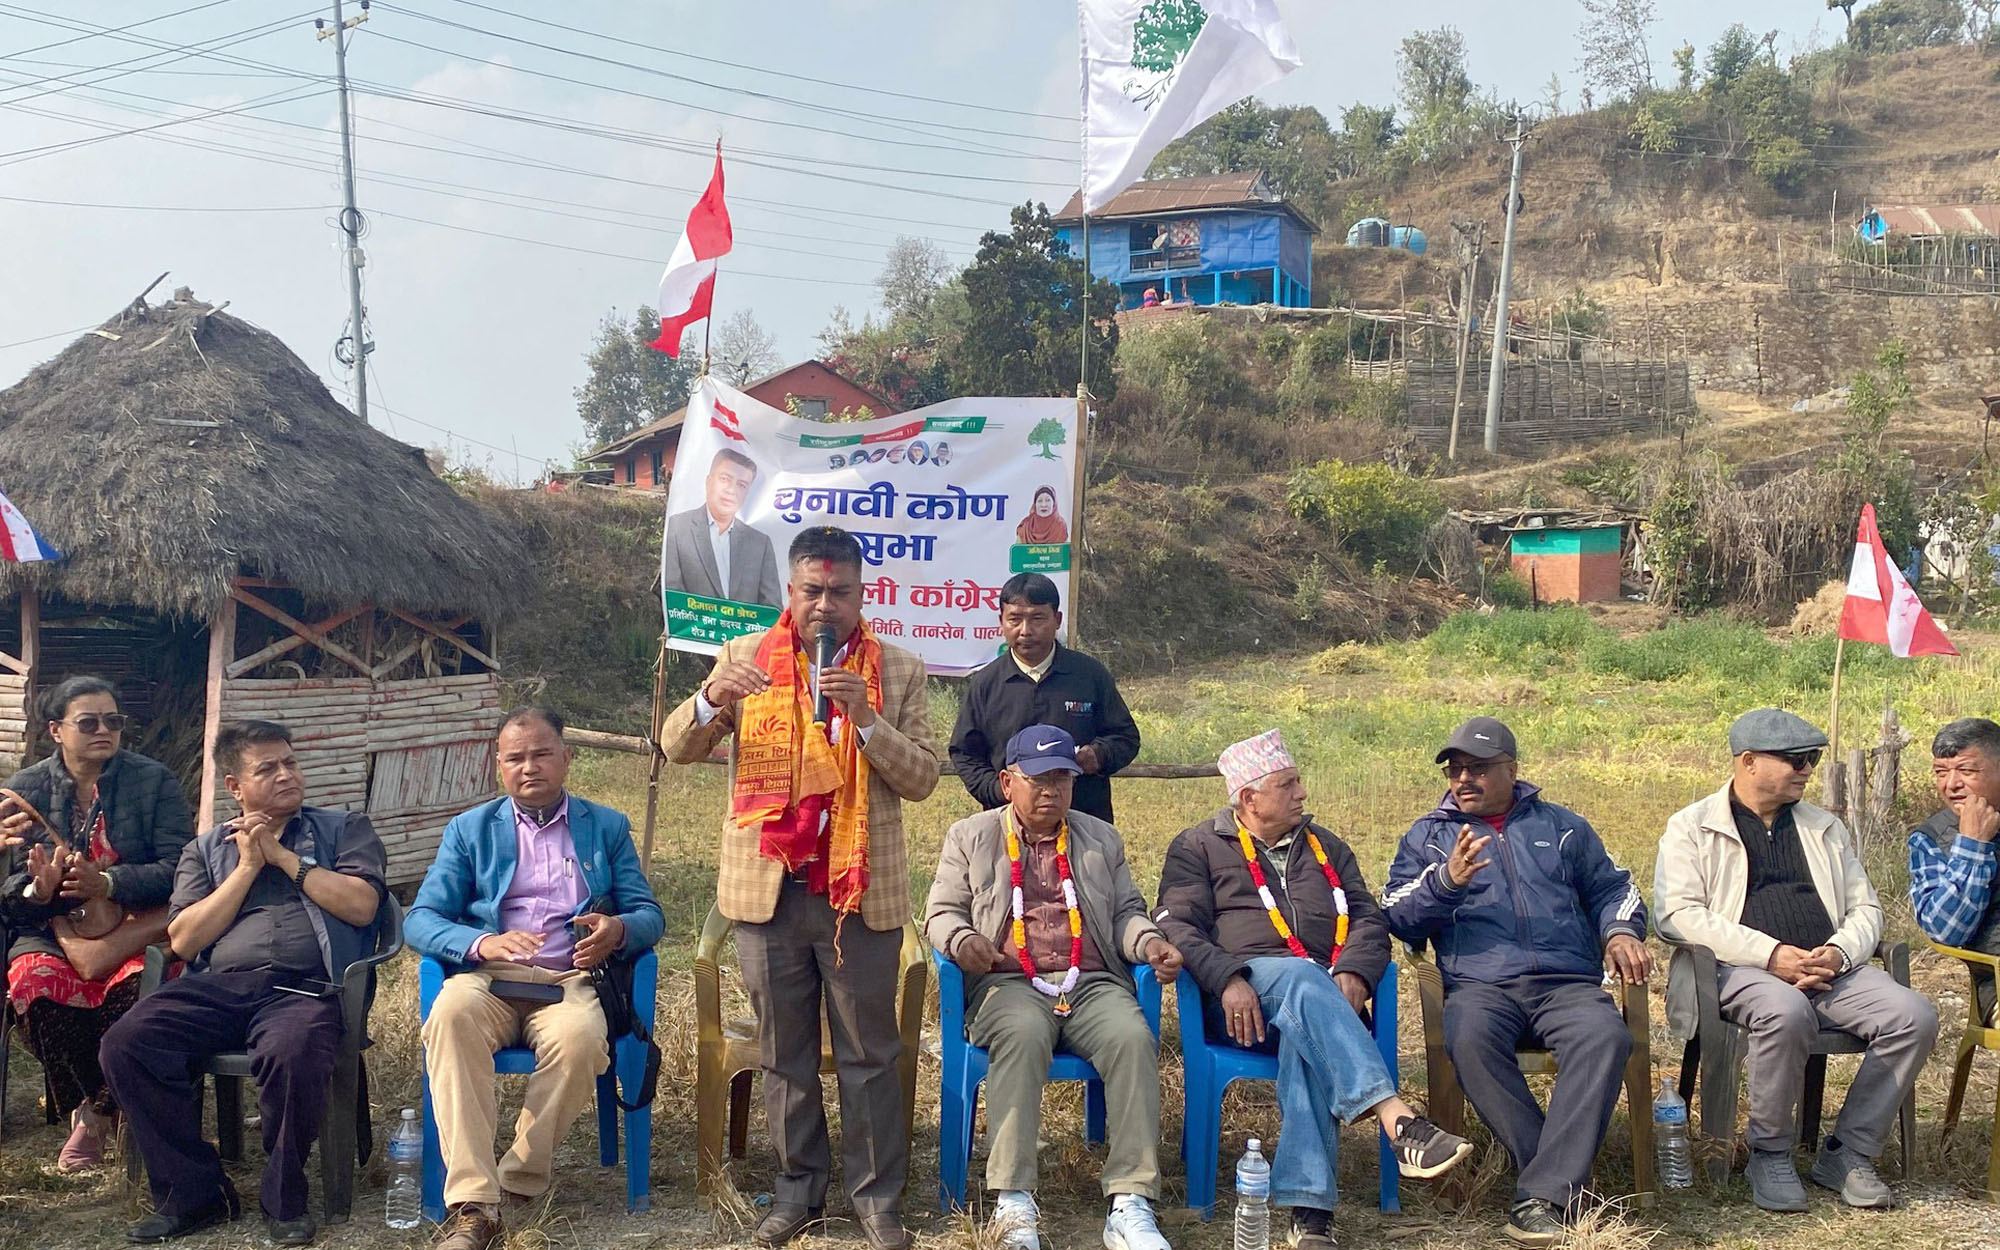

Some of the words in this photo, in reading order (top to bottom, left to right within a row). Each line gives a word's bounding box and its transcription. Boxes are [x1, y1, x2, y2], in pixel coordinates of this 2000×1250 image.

[773, 481, 898, 524] चुनावी
[906, 484, 1009, 521] कोण
[850, 531, 938, 566] सभा
